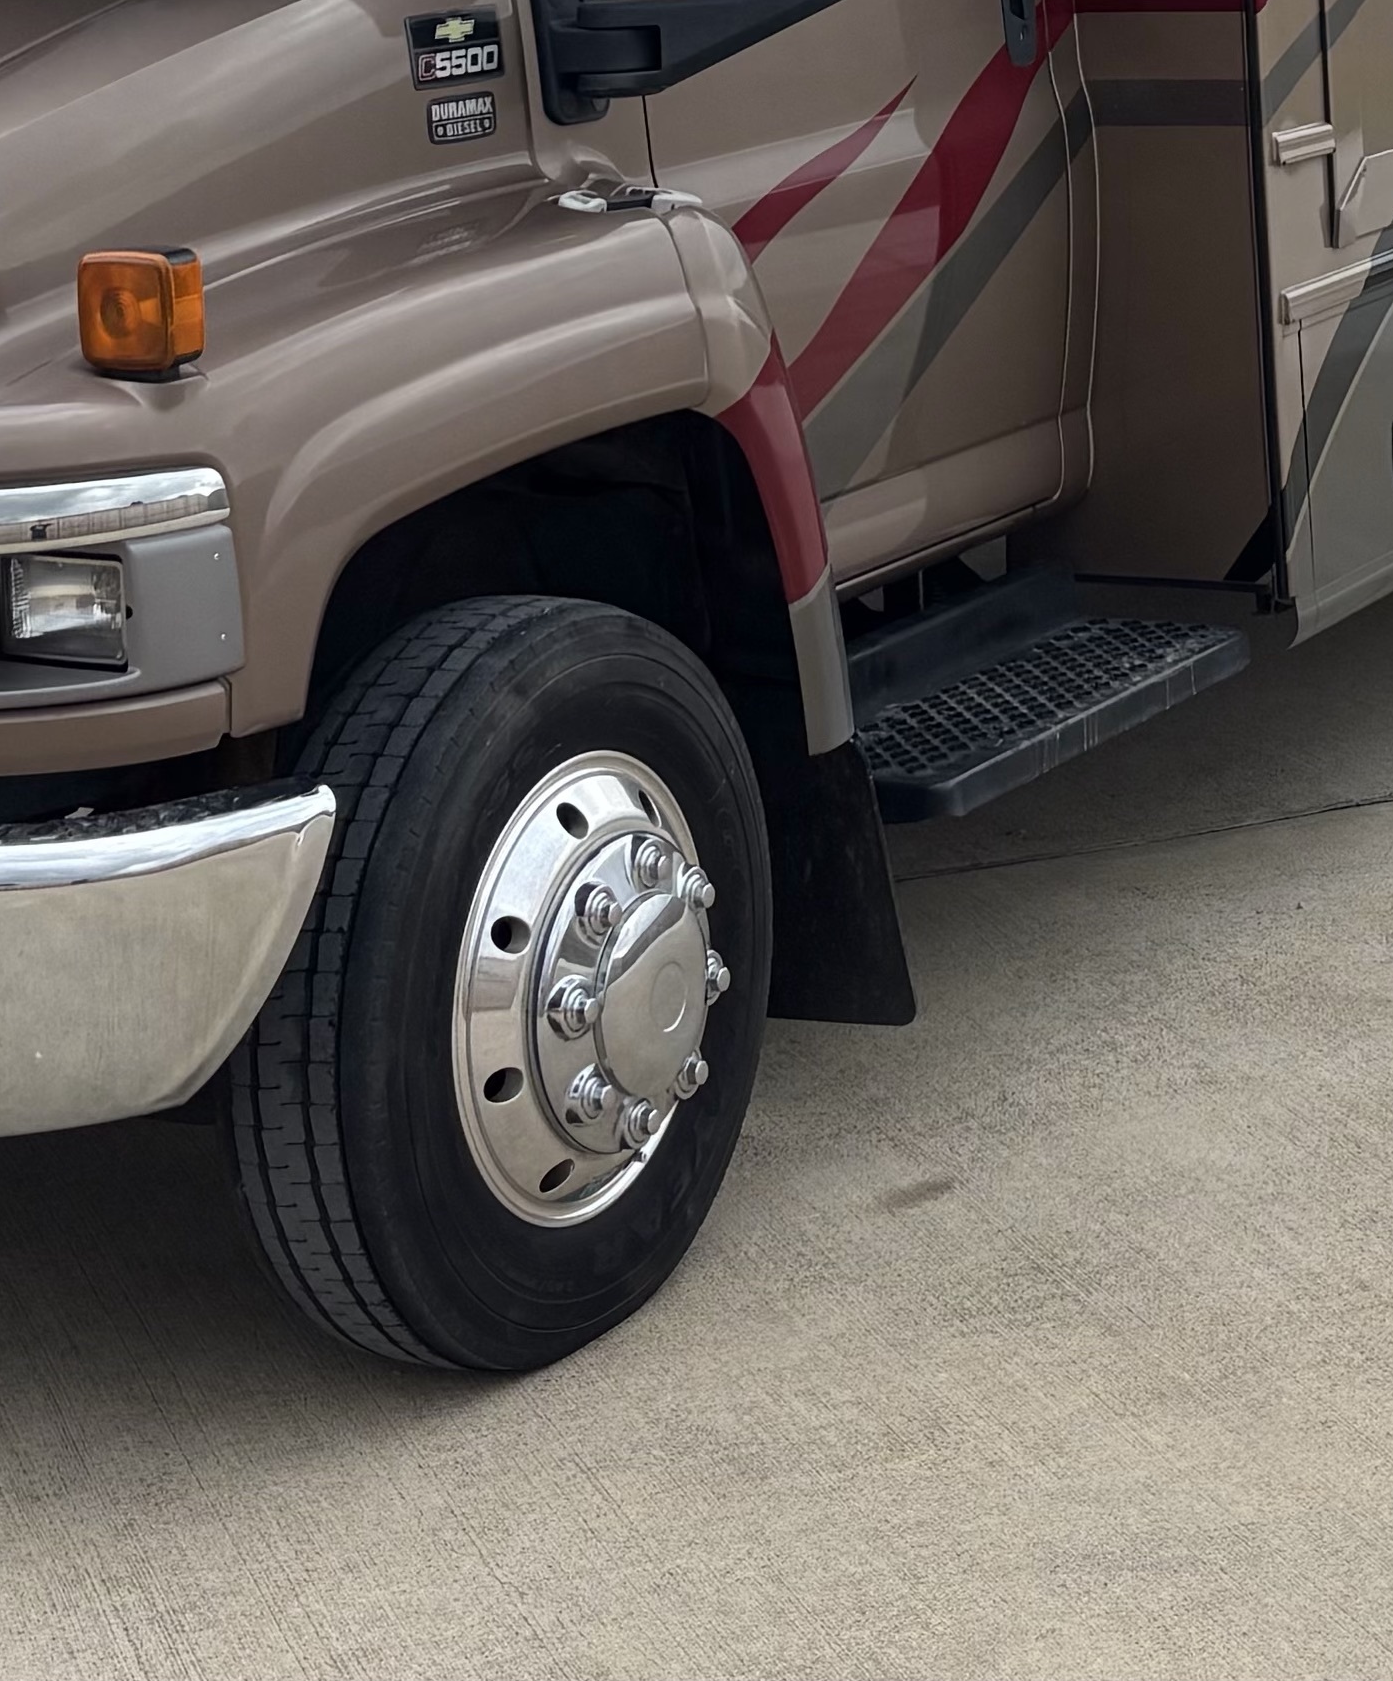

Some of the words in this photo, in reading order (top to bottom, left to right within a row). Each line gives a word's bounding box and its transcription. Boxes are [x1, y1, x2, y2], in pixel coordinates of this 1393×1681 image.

[418, 44, 499, 82] C5500
[431, 96, 494, 122] DURAMAX
[446, 119, 483, 137] DIESEL
